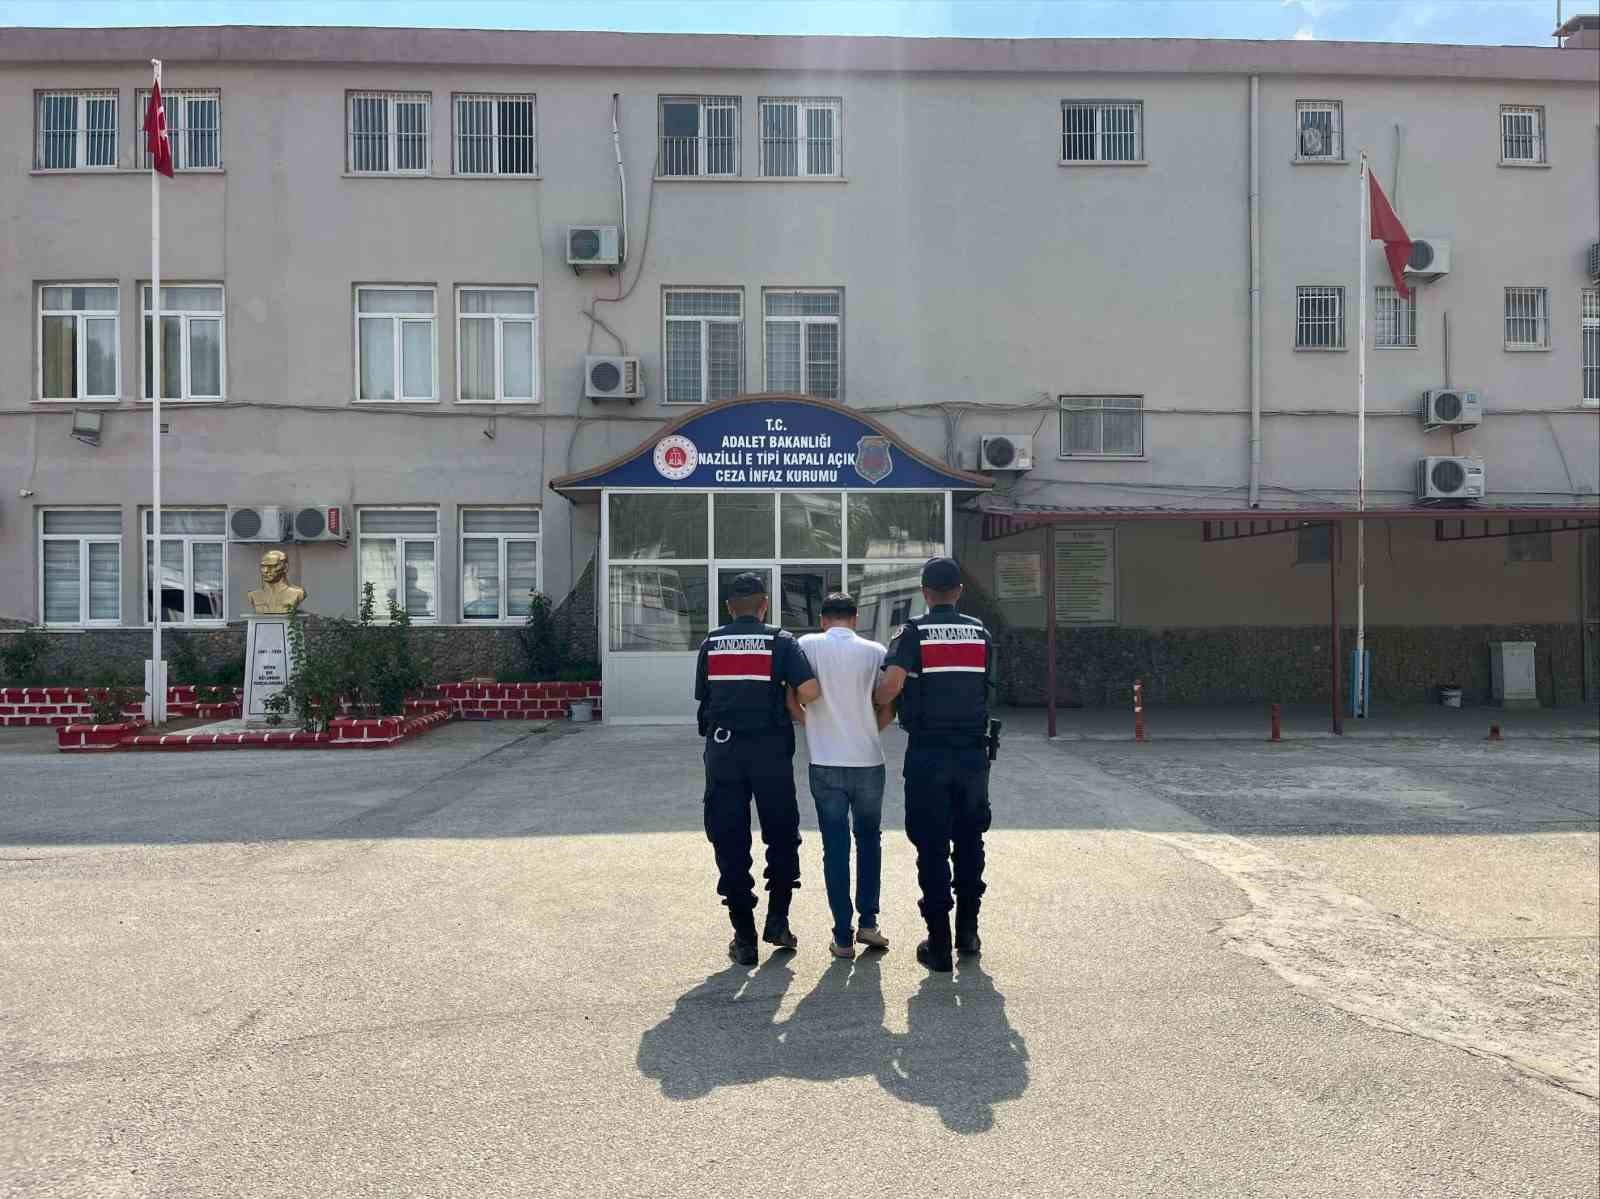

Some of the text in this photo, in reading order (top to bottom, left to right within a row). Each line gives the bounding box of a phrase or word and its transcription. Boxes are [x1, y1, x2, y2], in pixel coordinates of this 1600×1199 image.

[765, 418, 788, 431] T.C.
[721, 433, 831, 449] ADALET BAKANLIĞI
[697, 450, 856, 469] NAZİLLİ E TİPİ KAPALI AÇIK
[715, 466, 838, 482] CEZA İNFAZ KURUMU
[926, 627, 979, 641] JANDARMA
[714, 639, 767, 650] JANDARMA
